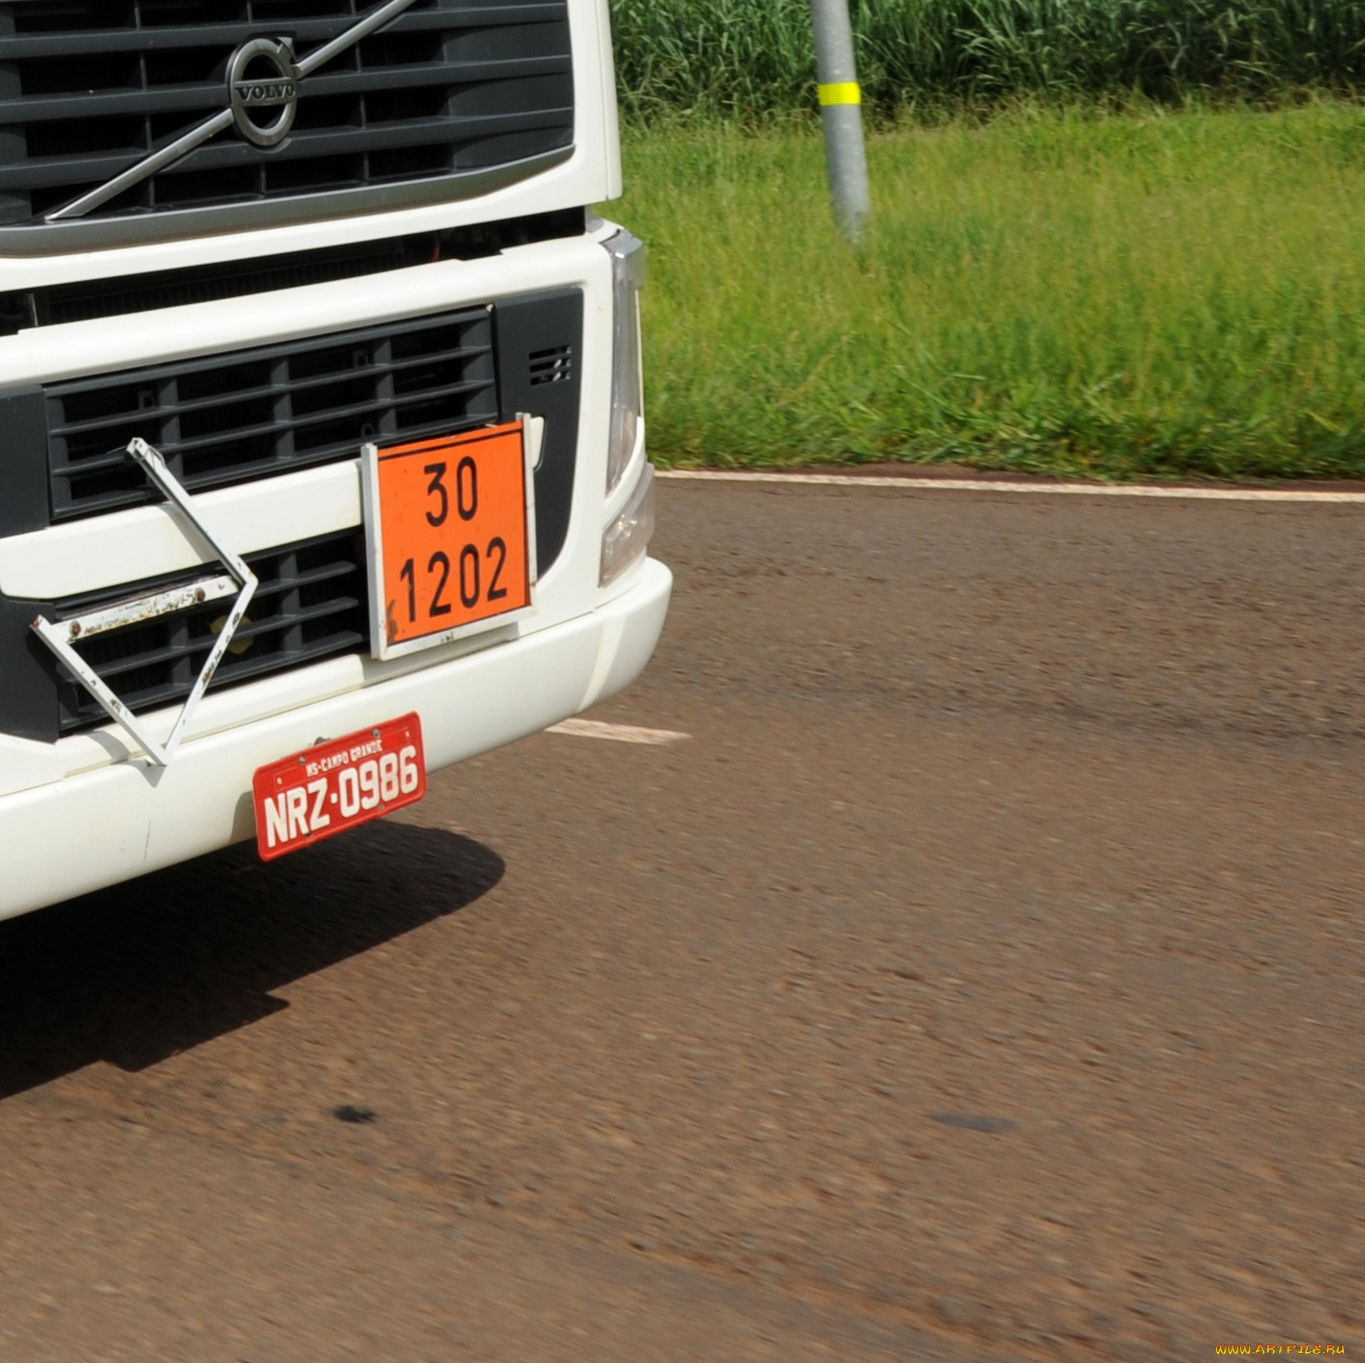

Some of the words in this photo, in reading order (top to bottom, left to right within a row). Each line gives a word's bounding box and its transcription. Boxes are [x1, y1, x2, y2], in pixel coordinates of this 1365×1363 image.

[235, 83, 296, 101] VOLVO
[424, 455, 479, 527] 30
[400, 536, 508, 624] 1202
[349, 738, 383, 762] GRANDE
